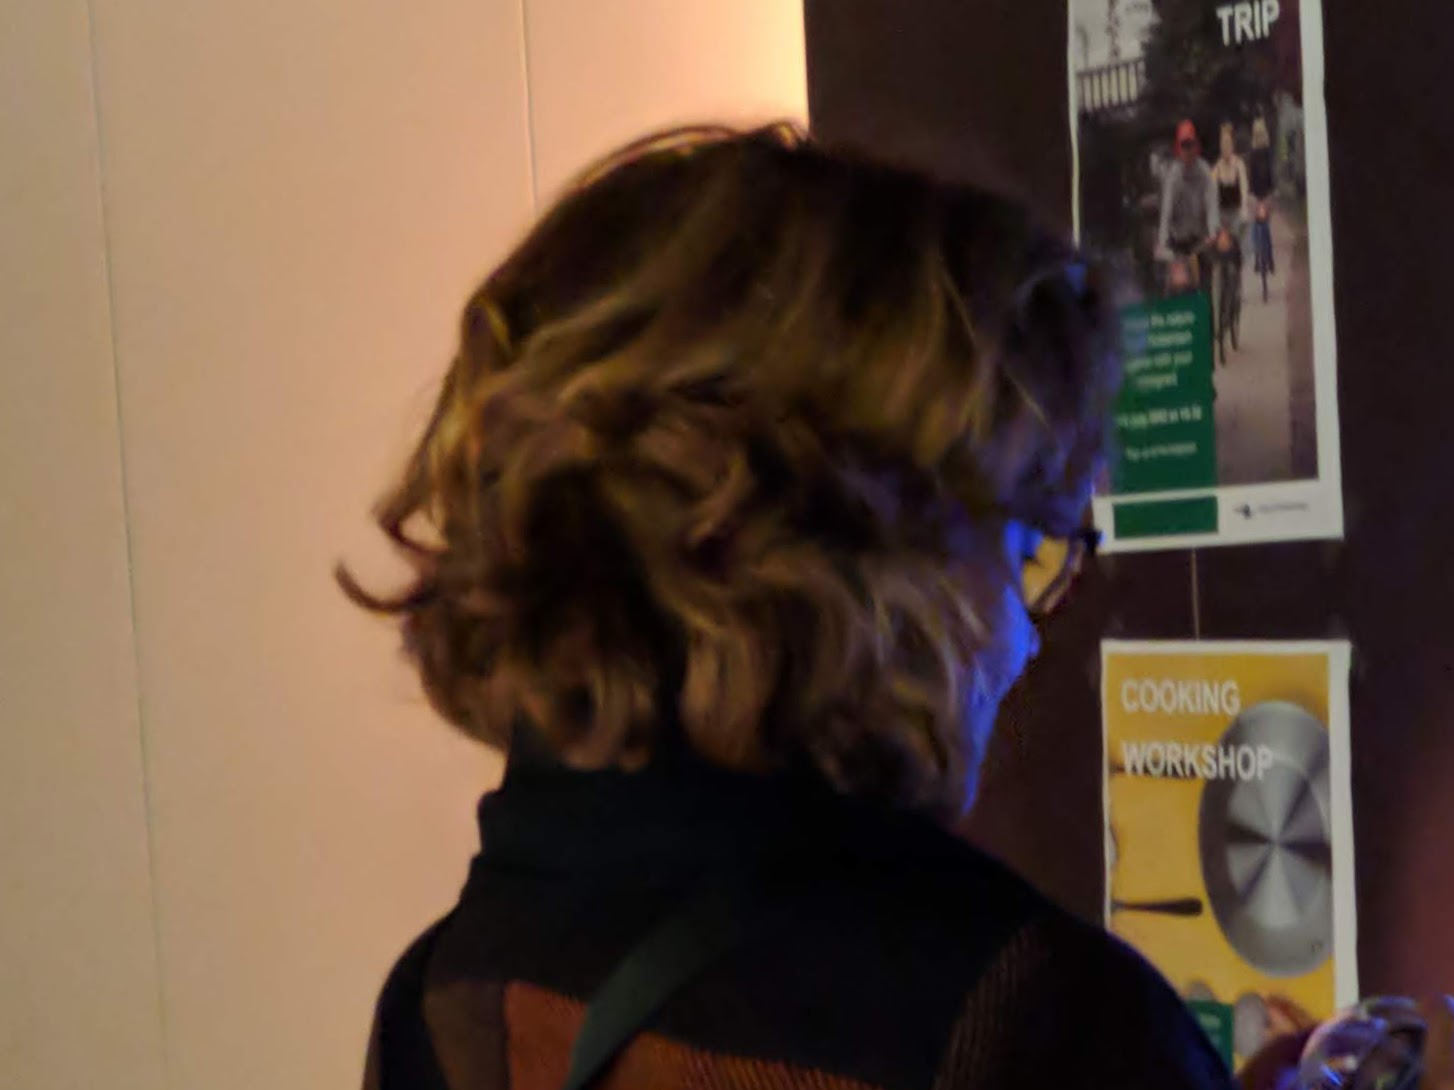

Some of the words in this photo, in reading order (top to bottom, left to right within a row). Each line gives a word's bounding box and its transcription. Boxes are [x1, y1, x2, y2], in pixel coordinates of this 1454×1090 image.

[1216, 0, 1280, 46] TRIP
[1121, 677, 1242, 716] COOKING
[1120, 741, 1274, 782] WORKSHOP
